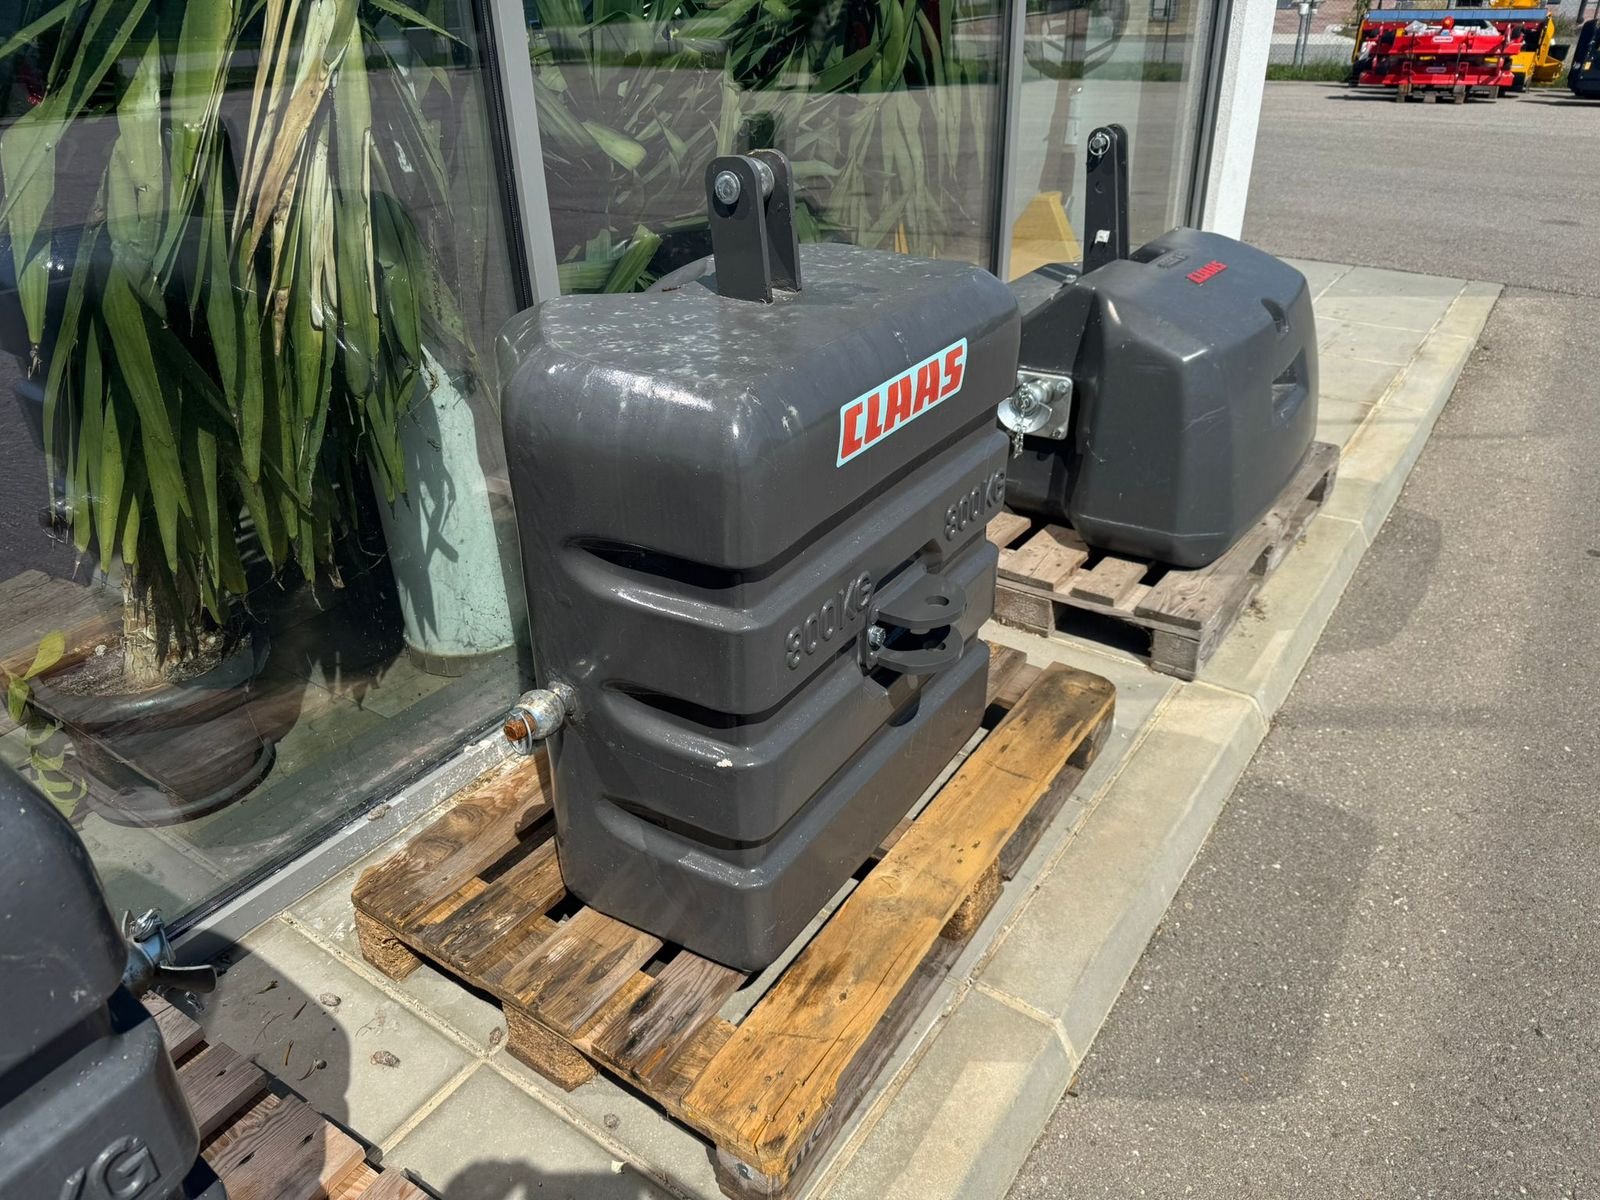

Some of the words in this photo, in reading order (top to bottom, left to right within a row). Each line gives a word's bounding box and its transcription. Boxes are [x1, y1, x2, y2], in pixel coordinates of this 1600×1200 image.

[841, 344, 964, 459] CLAAS
[944, 467, 1005, 541] 800KG
[785, 570, 872, 670] 800KG
